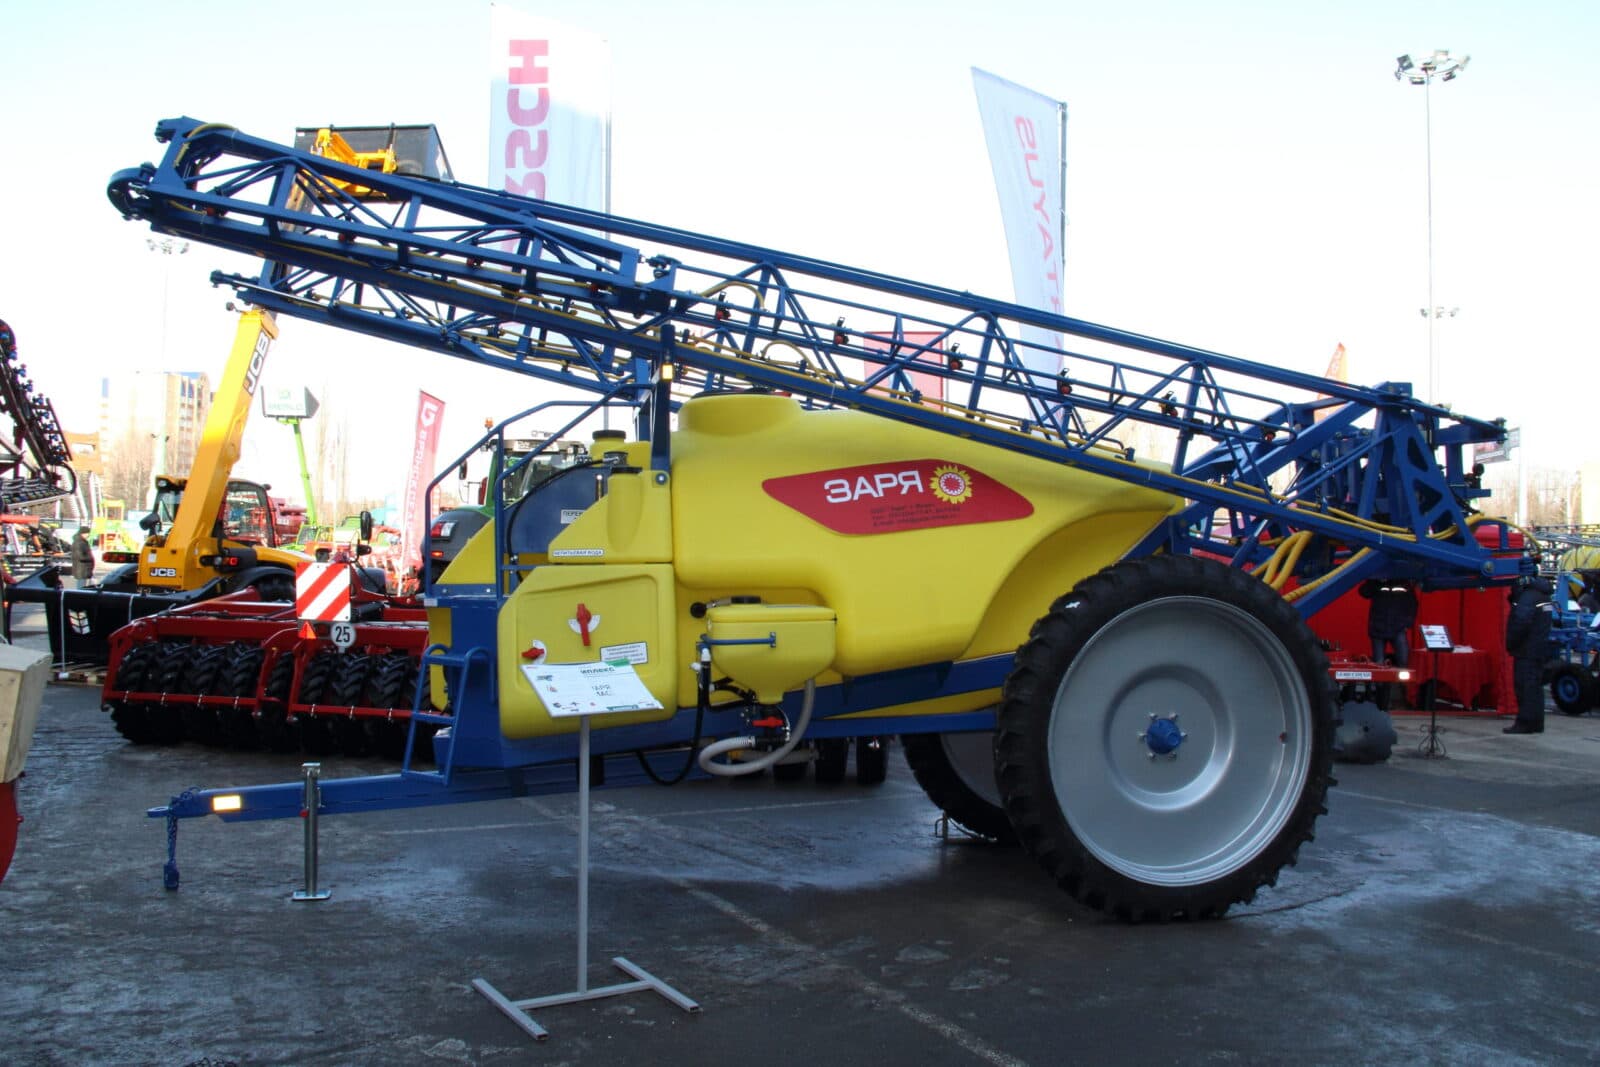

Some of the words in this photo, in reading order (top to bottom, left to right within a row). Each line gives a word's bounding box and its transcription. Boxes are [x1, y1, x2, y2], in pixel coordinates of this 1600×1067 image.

[246, 331, 269, 394] JCB
[823, 470, 924, 503] ЗАРЯ
[150, 568, 177, 577] JCB
[335, 627, 350, 643] 25
